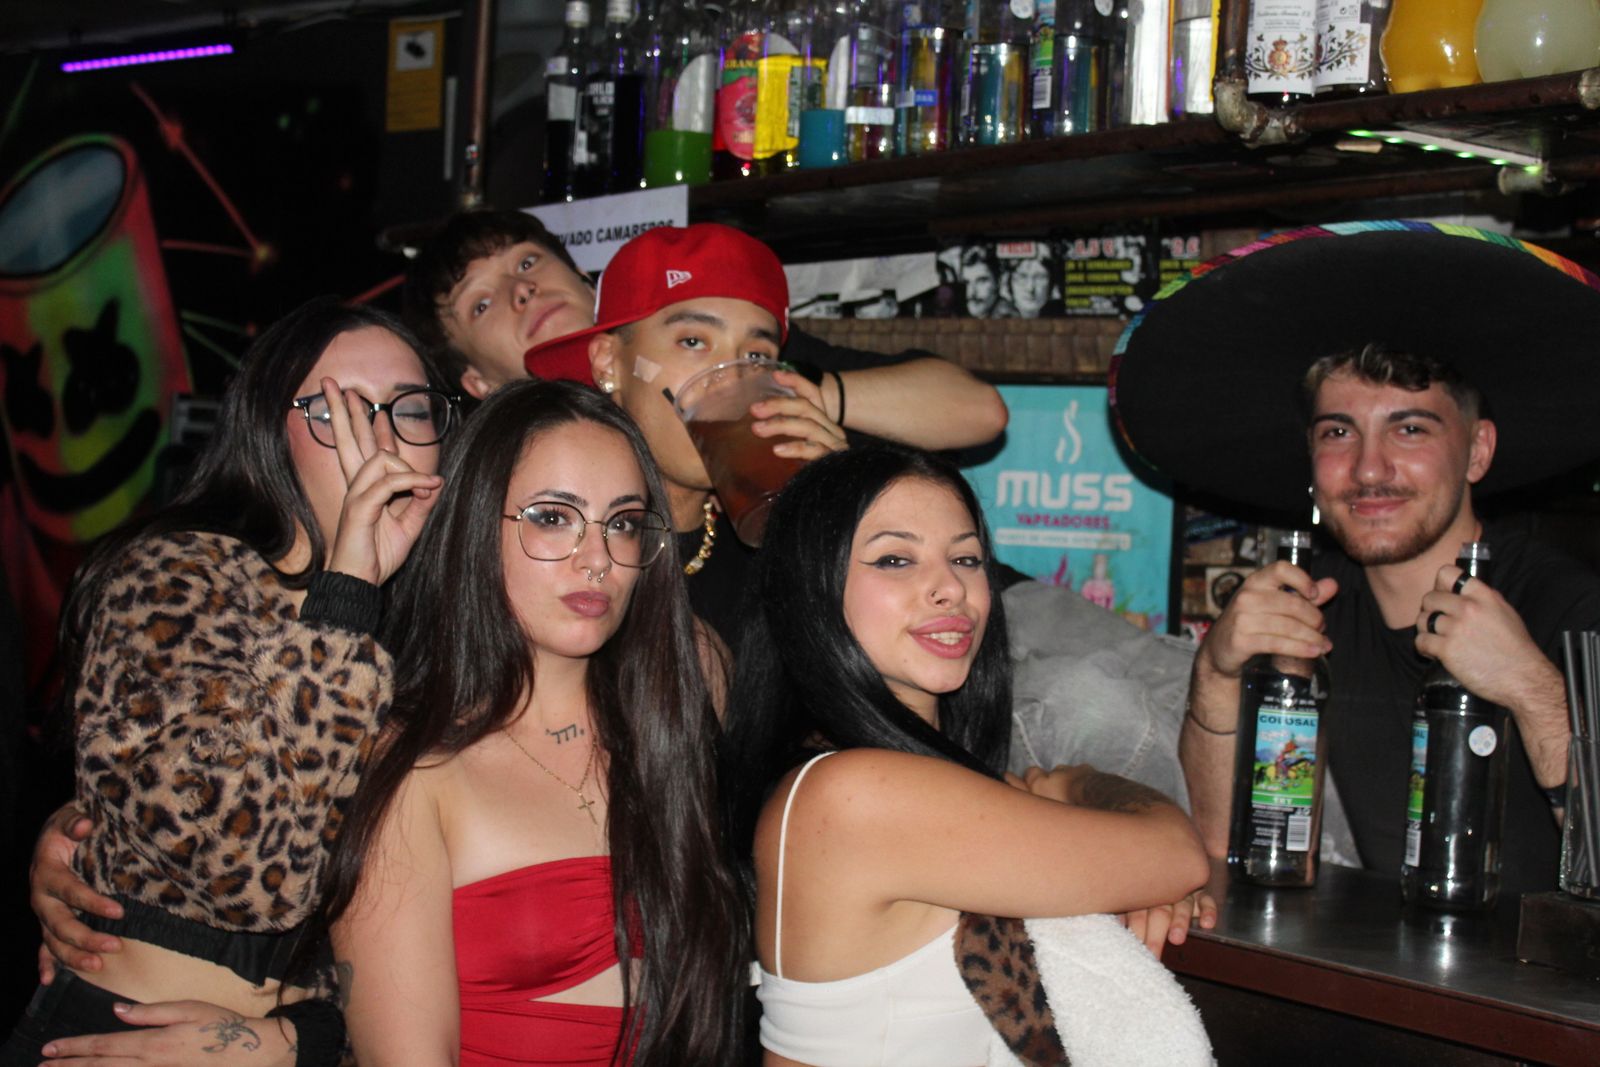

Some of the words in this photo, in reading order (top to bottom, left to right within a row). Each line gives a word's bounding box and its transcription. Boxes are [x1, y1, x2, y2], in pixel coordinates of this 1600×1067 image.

[559, 231, 592, 246] VADO
[996, 471, 1133, 511] MUSS
[1016, 513, 1110, 529] VAPEADORES
[1259, 715, 1317, 727] COLOSAL
